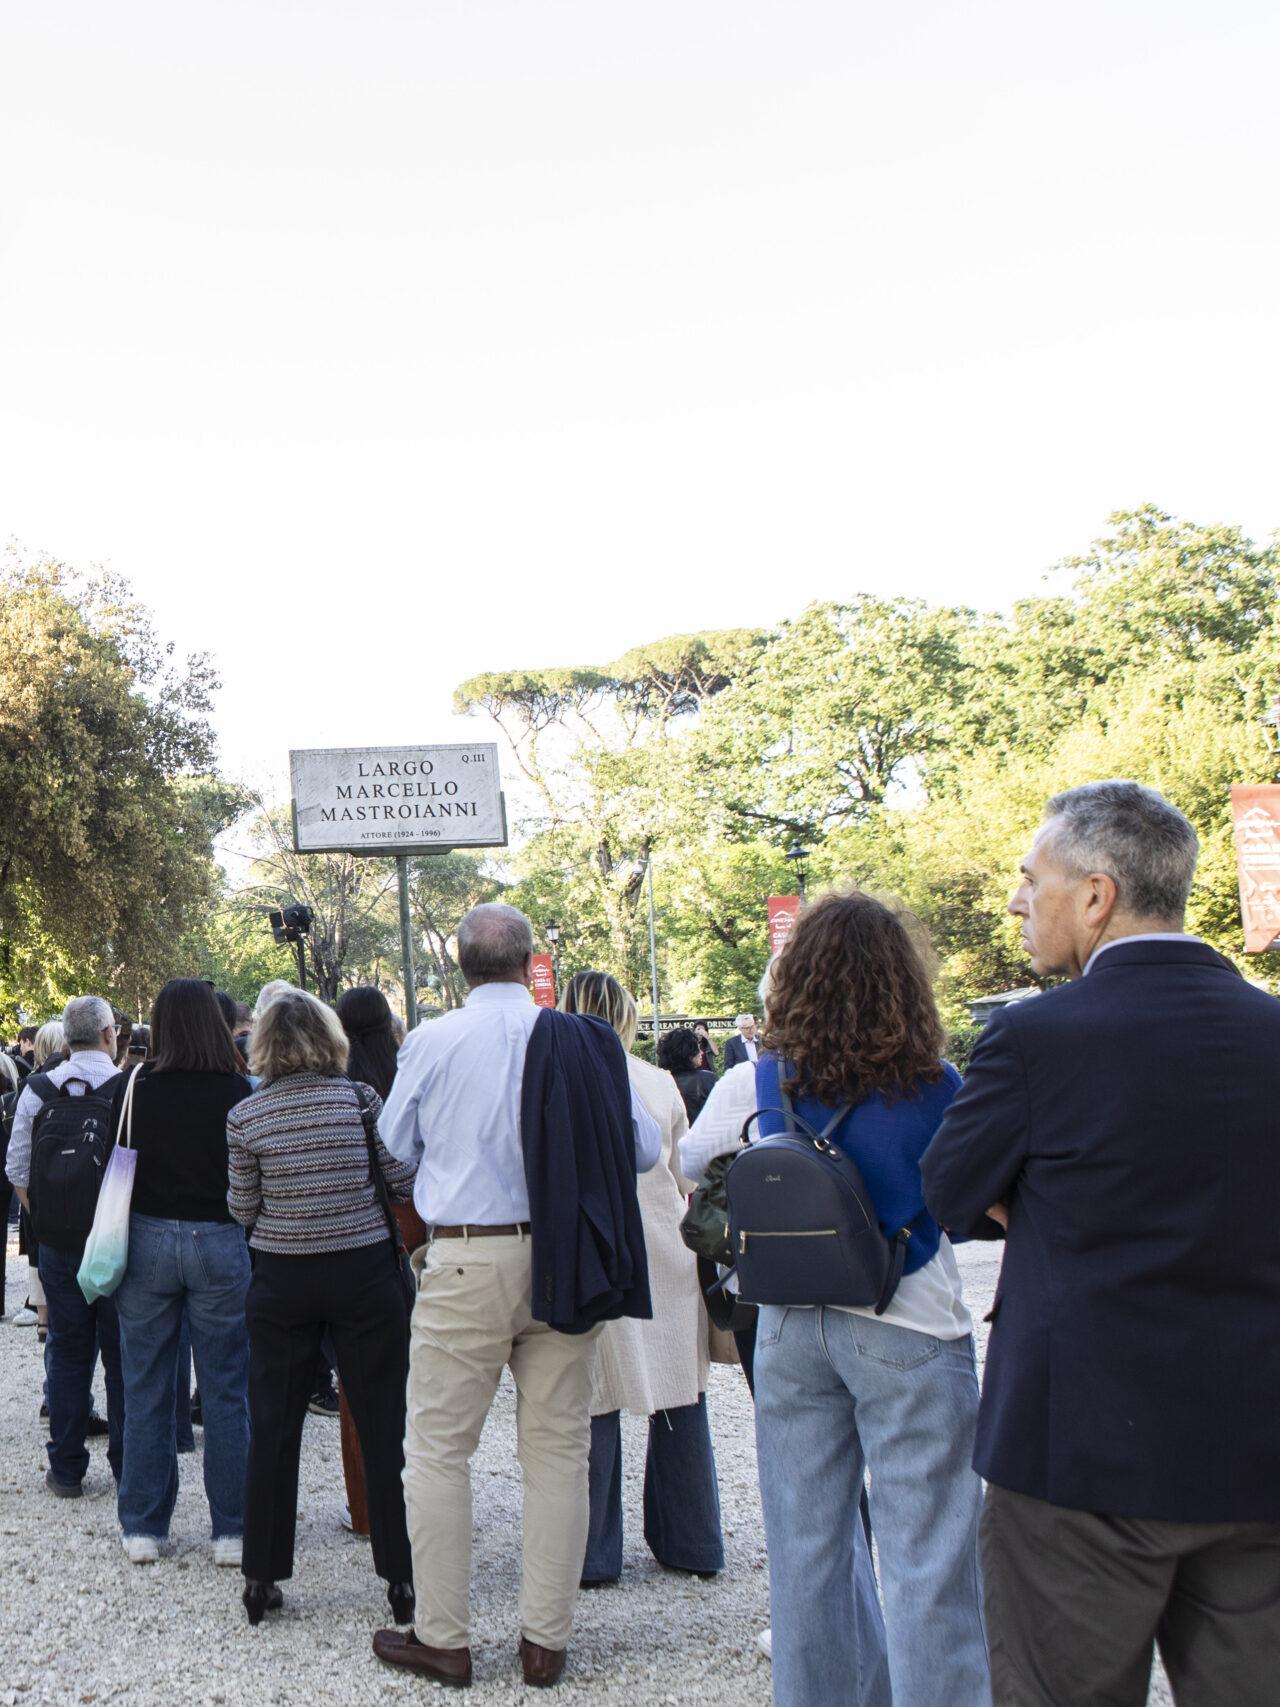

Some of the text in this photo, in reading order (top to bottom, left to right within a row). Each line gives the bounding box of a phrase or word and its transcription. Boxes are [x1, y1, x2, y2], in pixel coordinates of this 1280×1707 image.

[461, 754, 485, 763] Q.III
[358, 760, 434, 777] LARGO
[335, 781, 458, 800] MARCELLO
[320, 802, 478, 822] MASTROIANNI
[360, 832, 393, 840] ATTORE
[394, 830, 414, 839] (1924
[421, 829, 441, 838] 1996)
